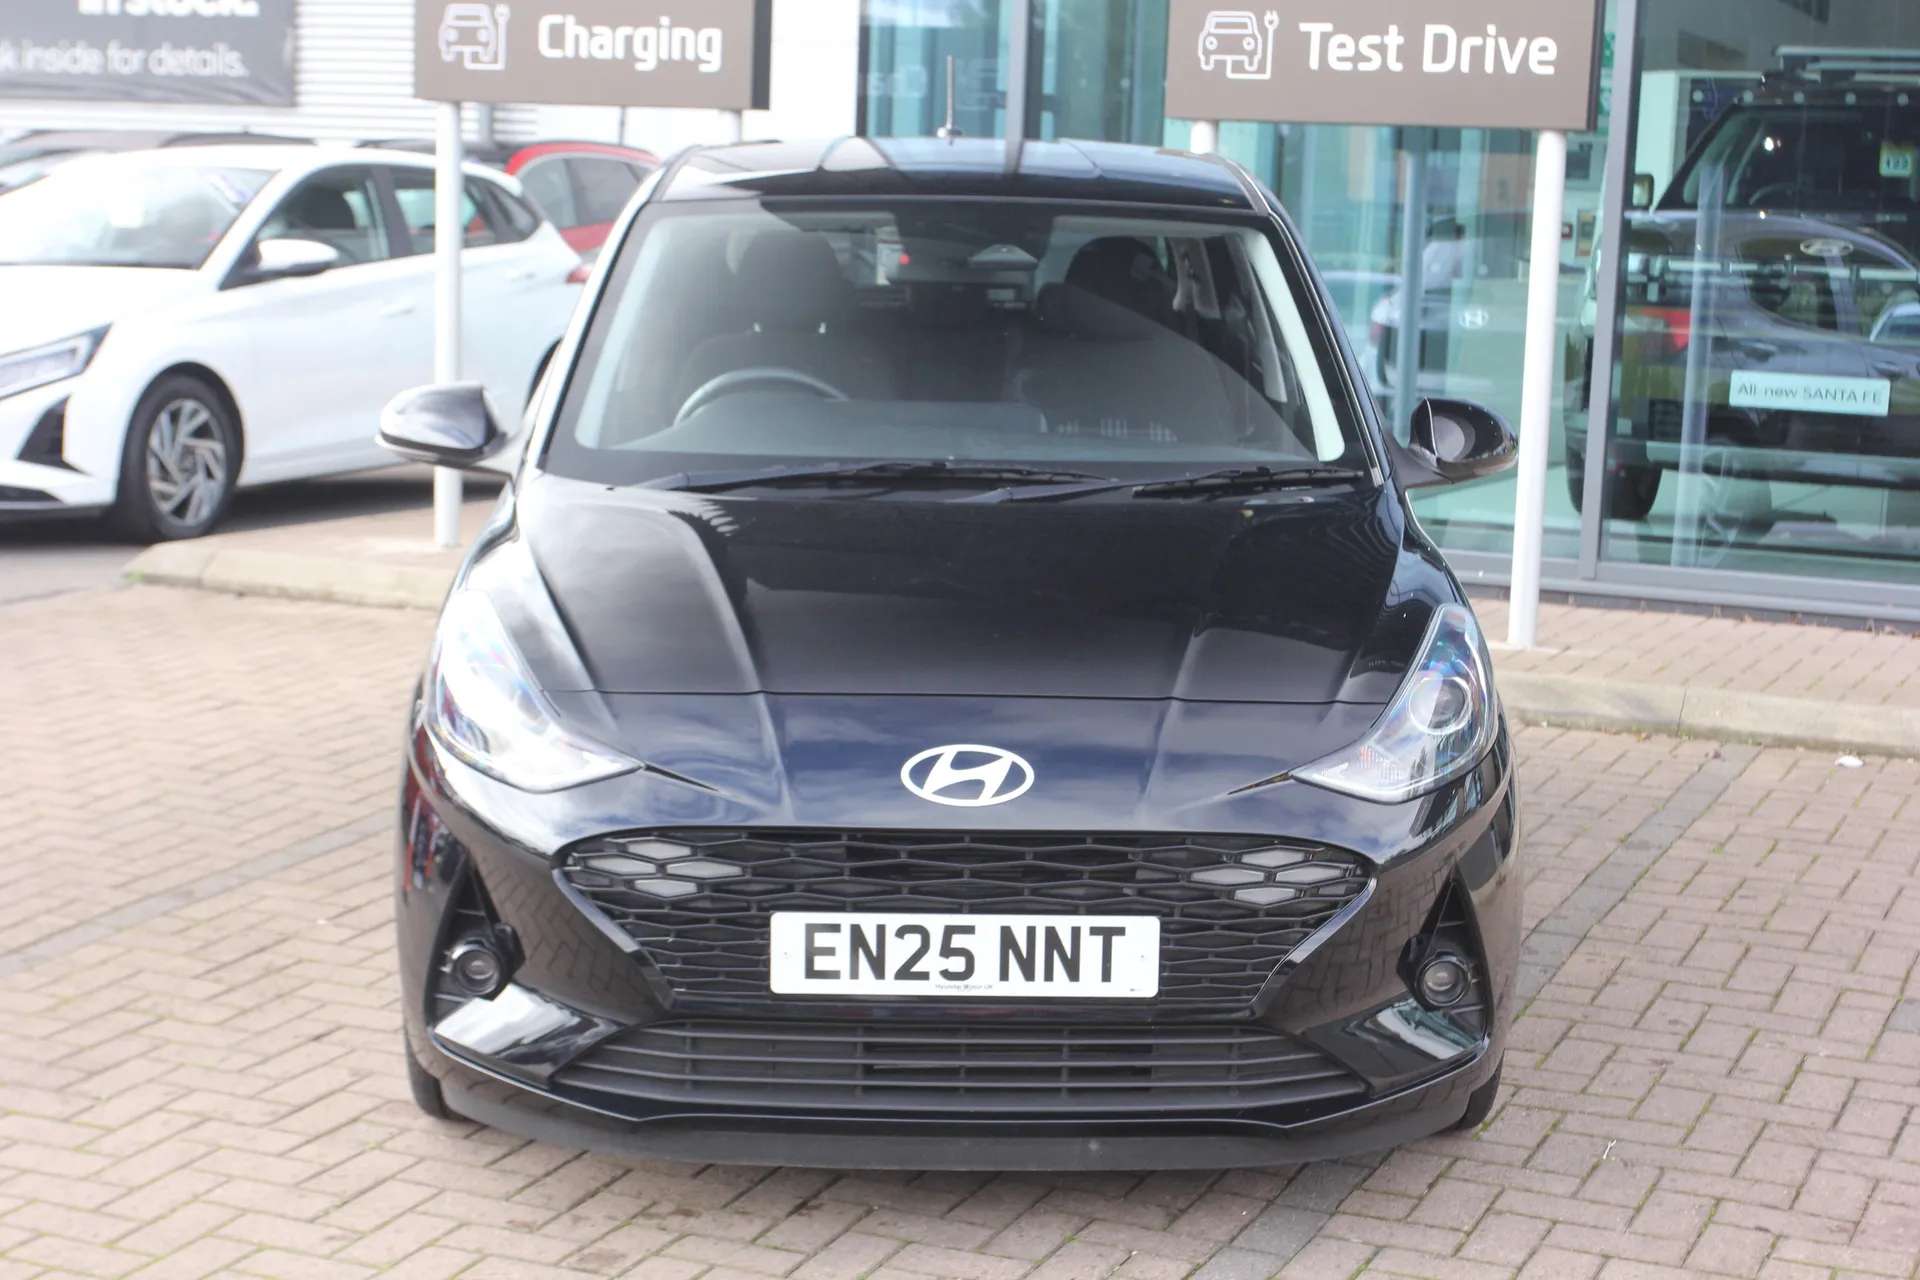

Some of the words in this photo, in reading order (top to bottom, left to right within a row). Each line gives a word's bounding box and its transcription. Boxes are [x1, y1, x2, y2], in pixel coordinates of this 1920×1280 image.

[22, 39, 104, 75] inside
[107, 39, 145, 75] for
[148, 41, 249, 78] details.
[538, 14, 723, 72] Charging
[1298, 22, 1405, 72] Test
[1422, 24, 1558, 76] Drive
[1737, 383, 1757, 396] All
[1763, 385, 1798, 399] new
[1802, 386, 1858, 404] SANTA
[804, 923, 976, 982] EN25
[999, 925, 1127, 983] NNT
